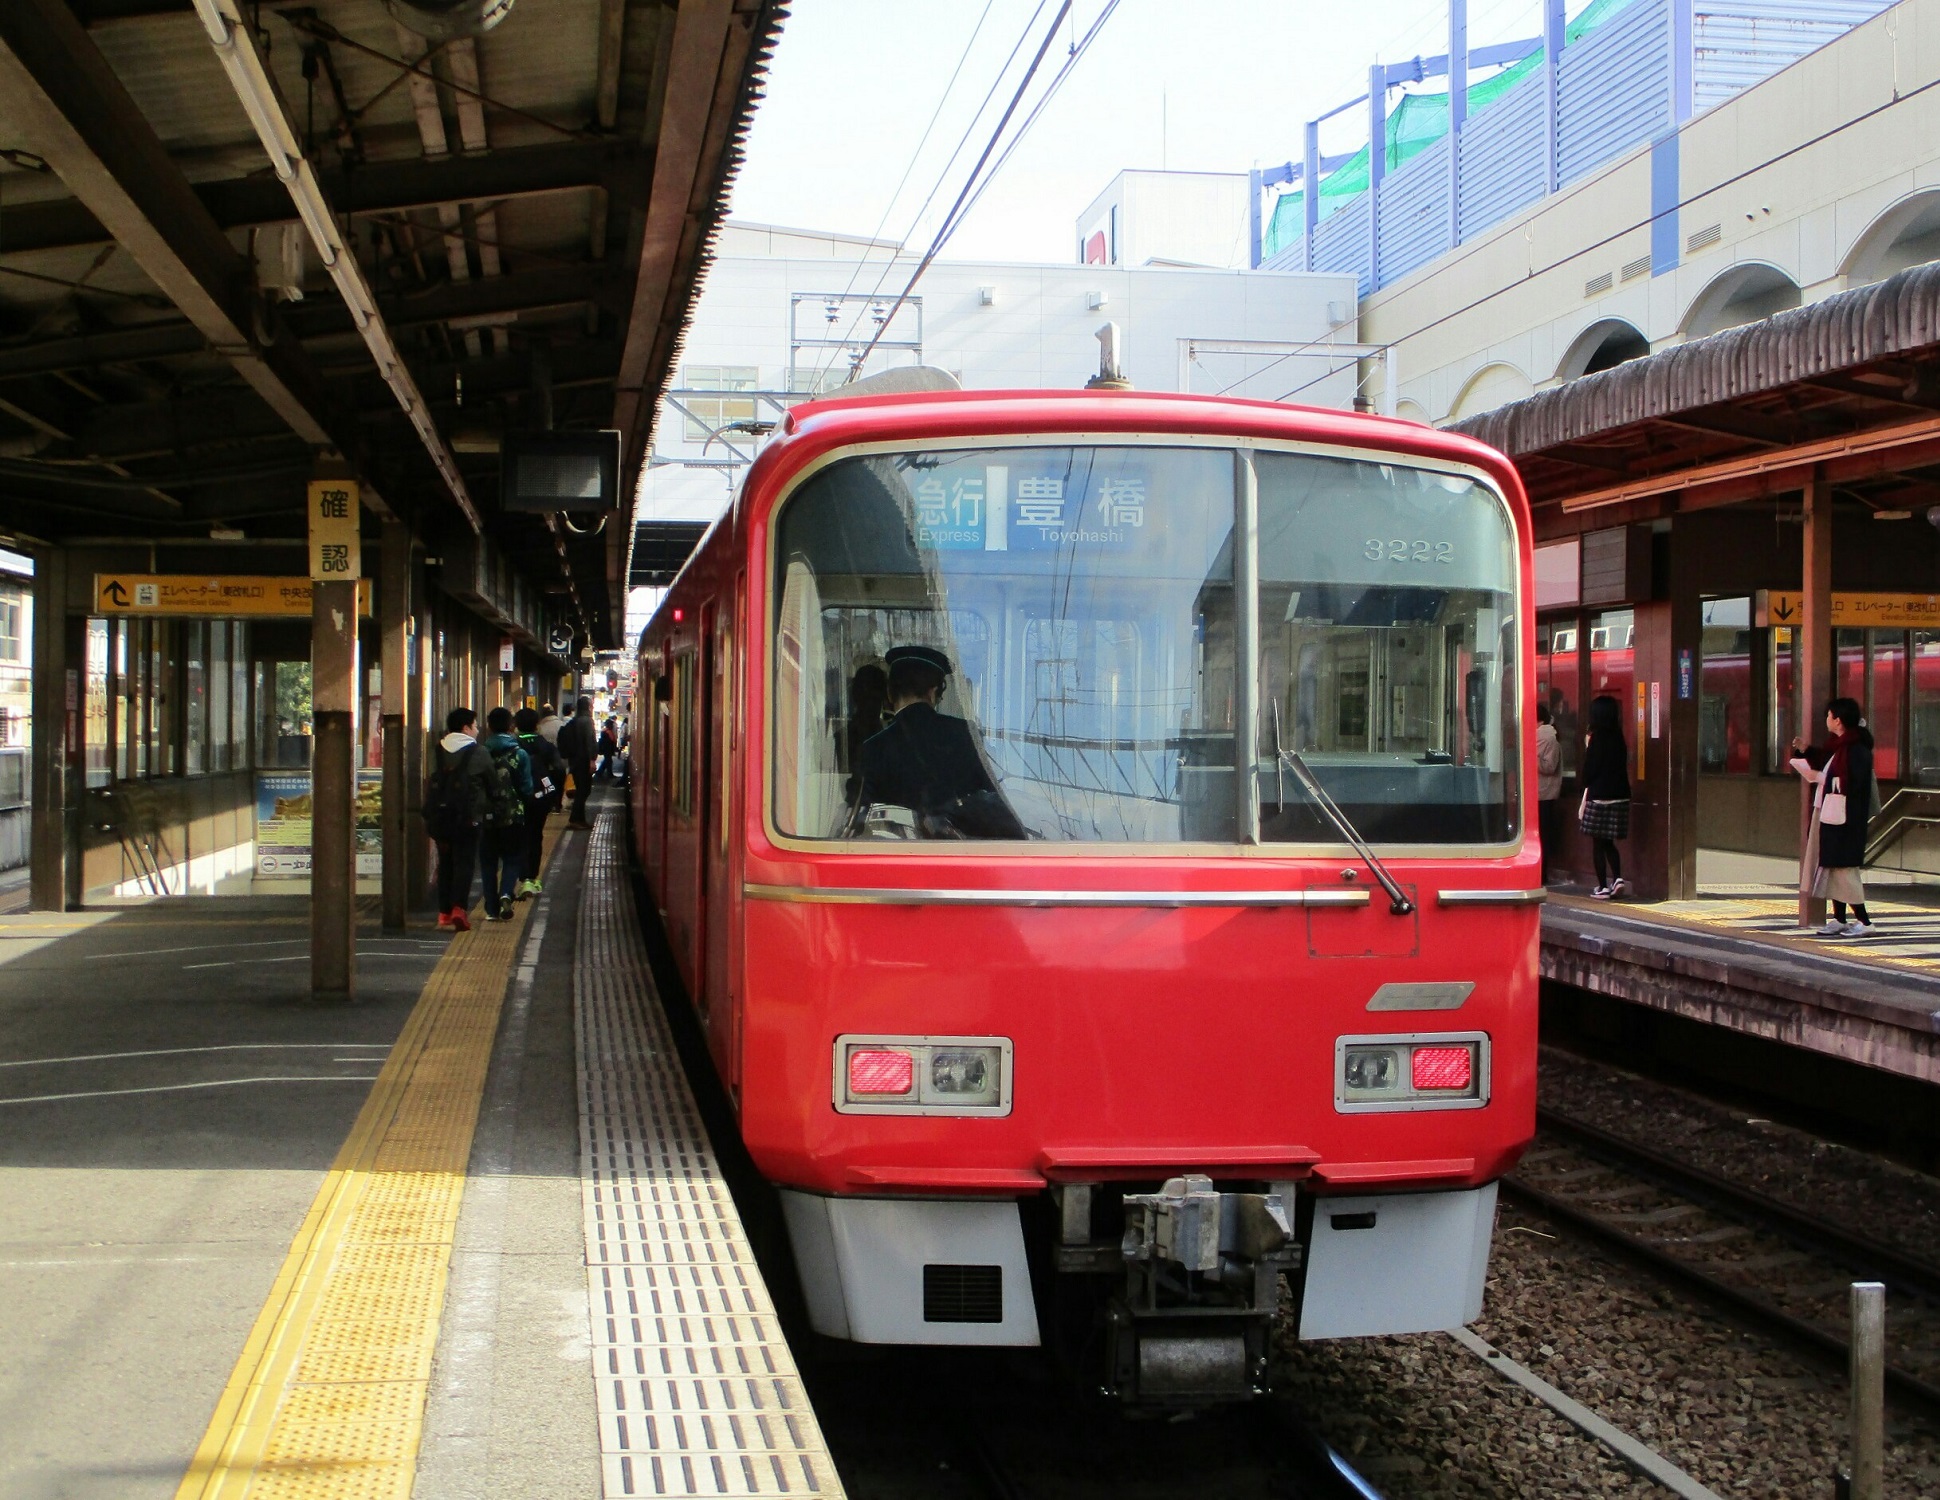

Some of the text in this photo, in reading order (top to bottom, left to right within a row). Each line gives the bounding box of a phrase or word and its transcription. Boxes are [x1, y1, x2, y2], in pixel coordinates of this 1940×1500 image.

[916, 477, 984, 526] 急行
[1015, 476, 1146, 527] 豊橋
[320, 489, 350, 573] 確認
[919, 527, 980, 544] Express
[1038, 527, 1124, 544] Toyohashi
[1364, 538, 1455, 564] 3222
